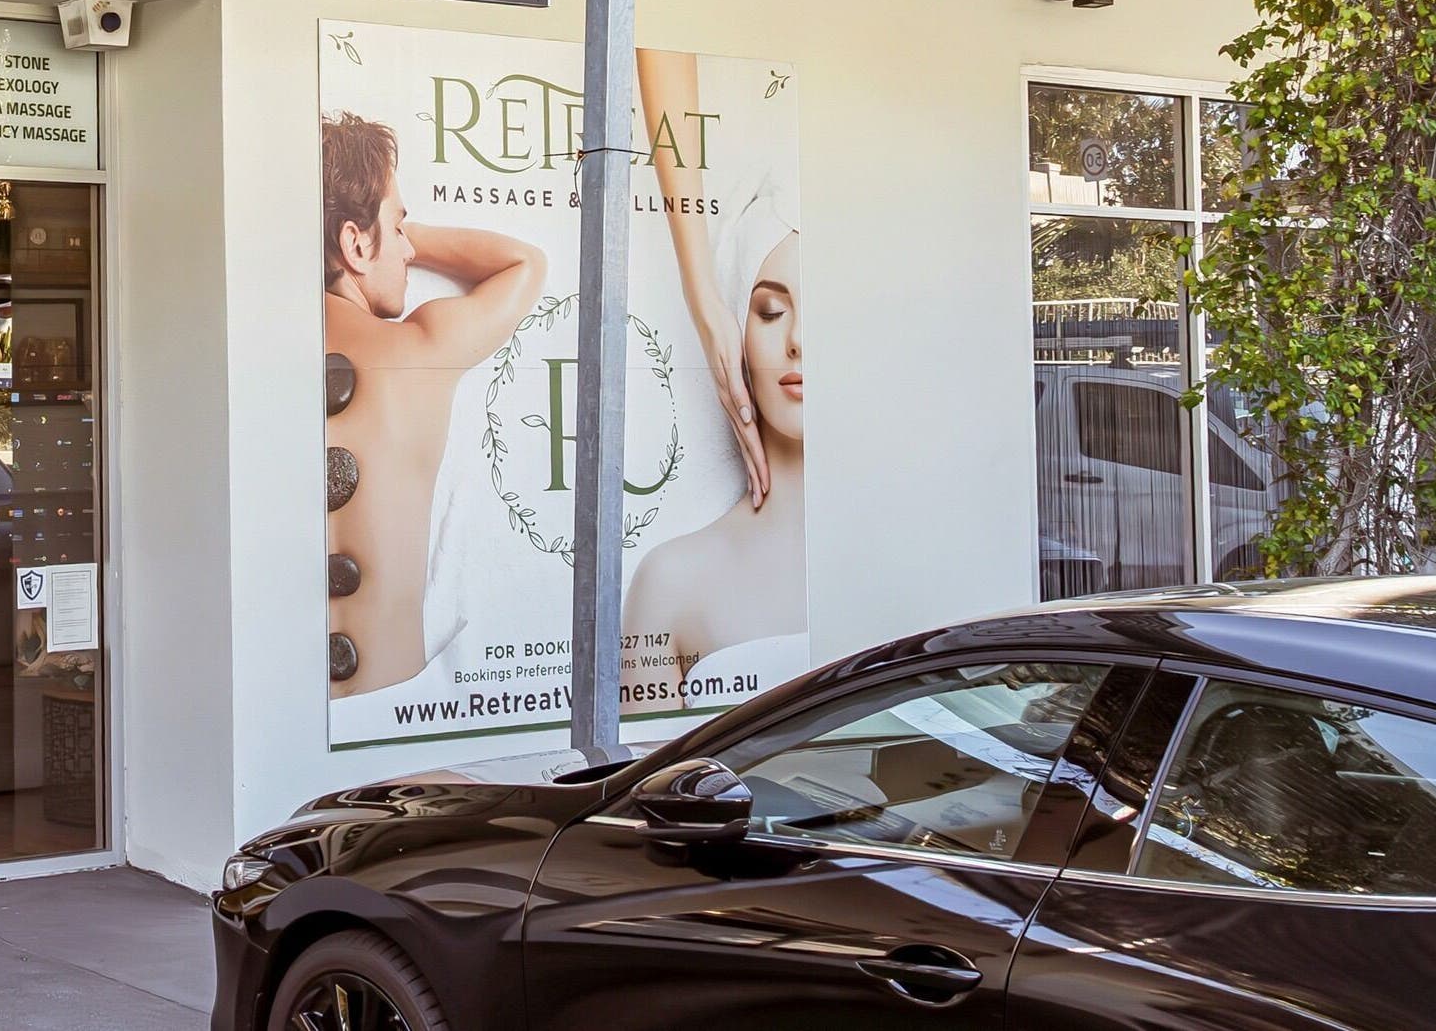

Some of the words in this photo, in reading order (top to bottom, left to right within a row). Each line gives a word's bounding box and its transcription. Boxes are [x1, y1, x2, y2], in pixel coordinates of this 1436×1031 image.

[5, 55, 50, 70] STONE
[7, 102, 71, 118] MASSAGE
[430, 74, 721, 173] RETAT
[23, 127, 86, 142] MASSAGE
[434, 185, 552, 207] MASSAGE
[568, 191, 580, 208] &
[635, 195, 720, 215] LLNESS
[486, 645, 514, 660] FOR
[644, 633, 670, 647] 1147
[455, 669, 511, 683] Bookings
[516, 662, 571, 678] Preferred
[640, 652, 699, 668] Welcomed
[395, 674, 758, 724] www.Retreatness.com.au
